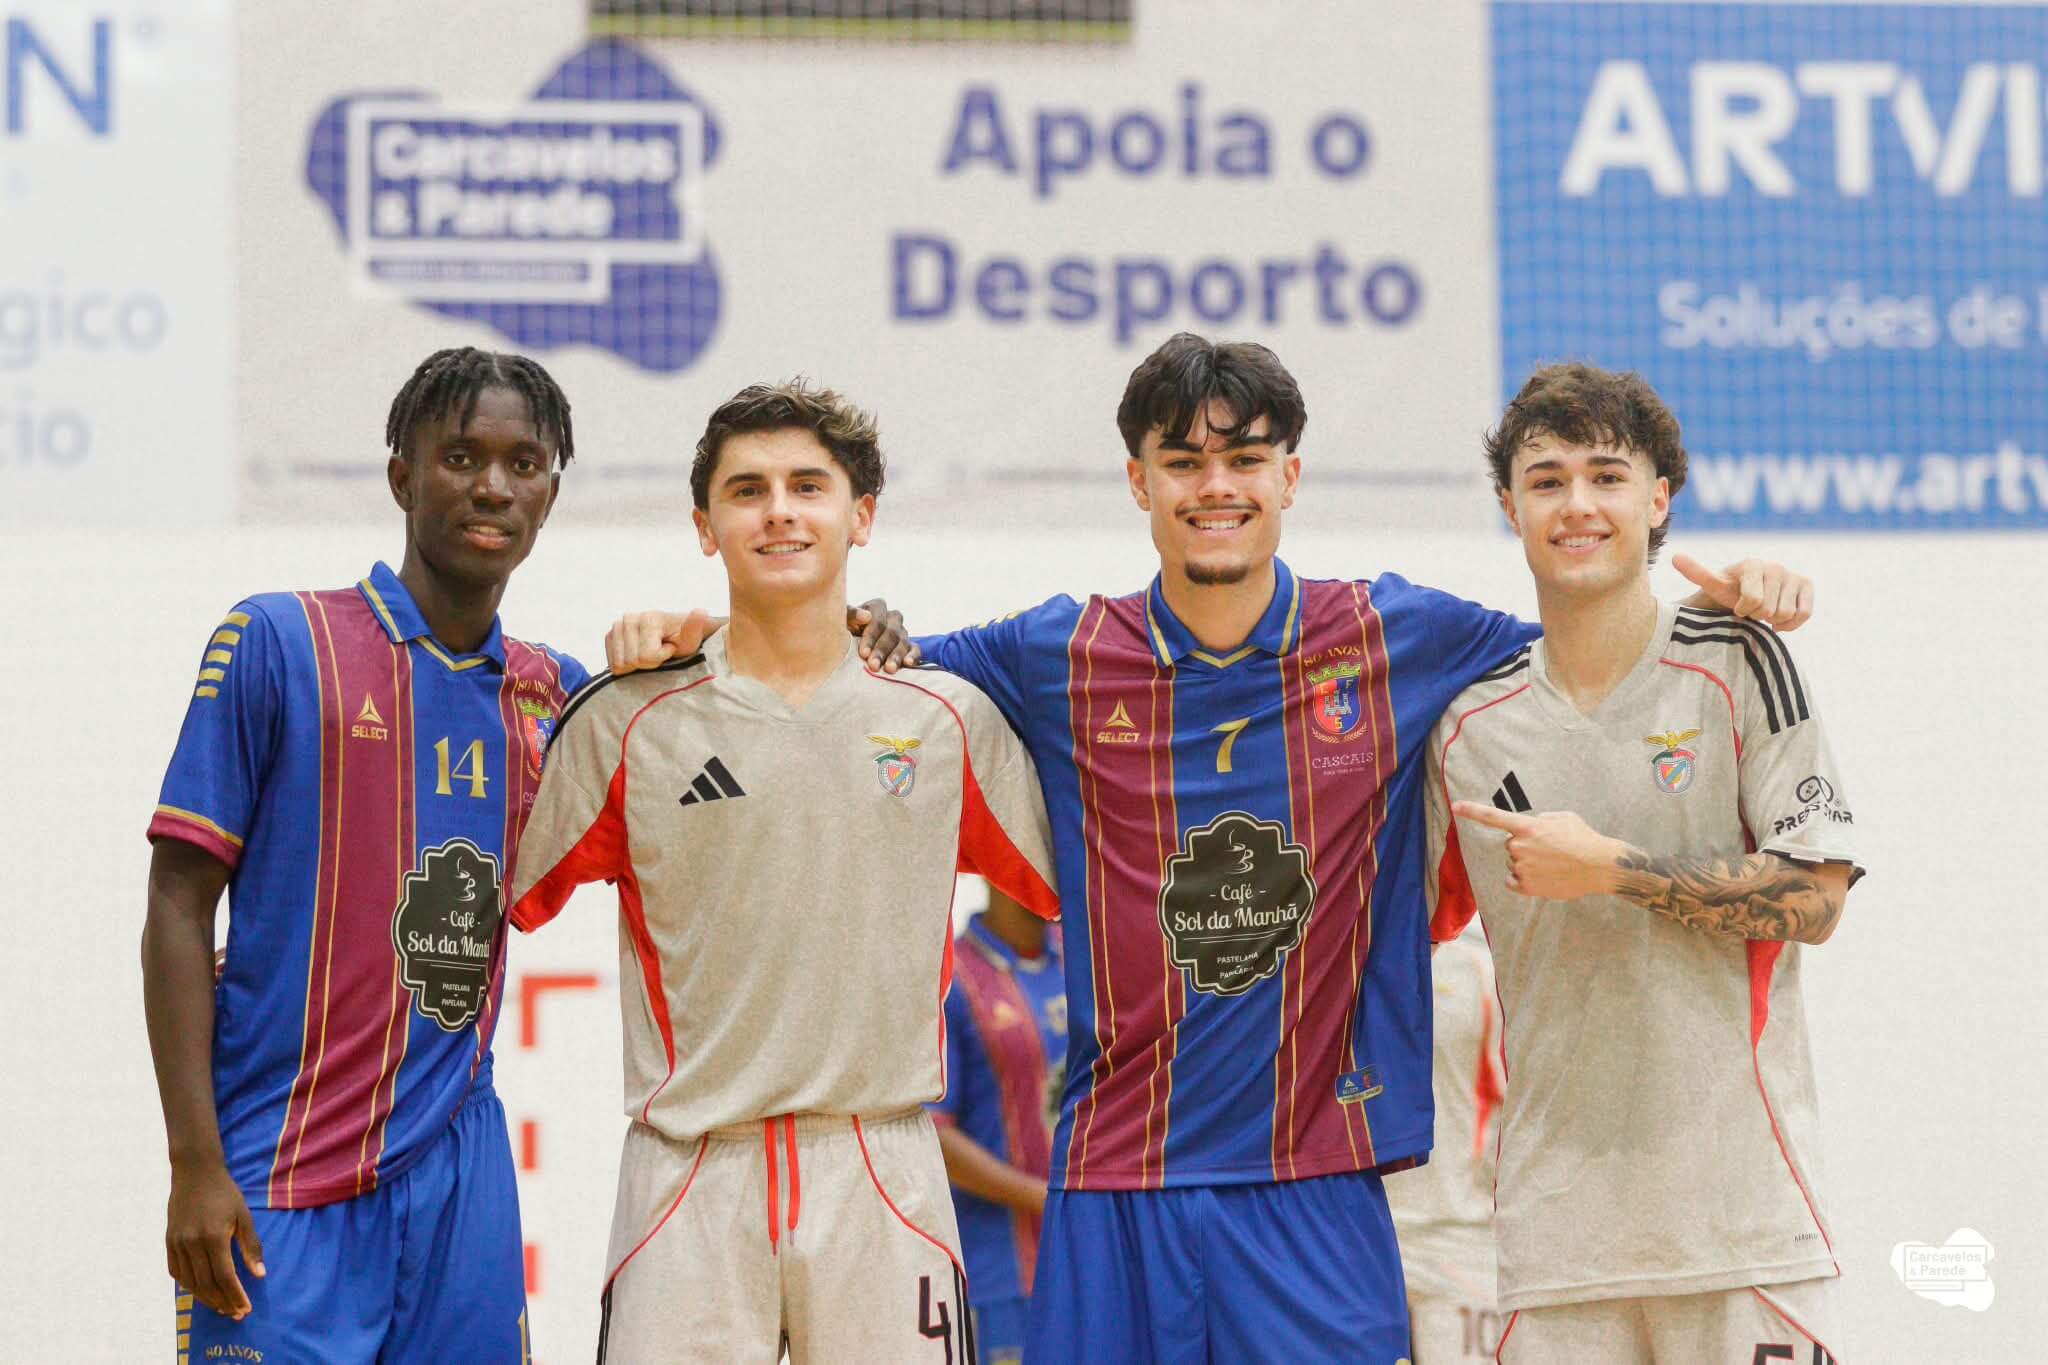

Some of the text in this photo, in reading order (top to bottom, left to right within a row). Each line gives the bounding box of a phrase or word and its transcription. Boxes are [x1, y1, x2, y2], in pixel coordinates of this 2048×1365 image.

[375, 125, 678, 184] Carcavelos
[943, 84, 1372, 199] Apoia o
[418, 184, 614, 237] Parede
[892, 234, 1424, 348] Desporto
[1659, 281, 1940, 362] Soluções
[1950, 285, 2029, 349] de
[0, 388, 93, 472] io
[352, 724, 389, 741] SELECT
[1096, 730, 1141, 745] SELECT
[1210, 716, 1251, 774] 7
[434, 736, 490, 800] 14
[1312, 752, 1374, 769] CASCAIS
[1174, 903, 1298, 932] Sol da Manhã
[1221, 882, 1254, 905] Café
[407, 930, 437, 953] Sol
[438, 935, 459, 956] da
[450, 910, 475, 933] Café
[918, 1276, 953, 1365] 4
